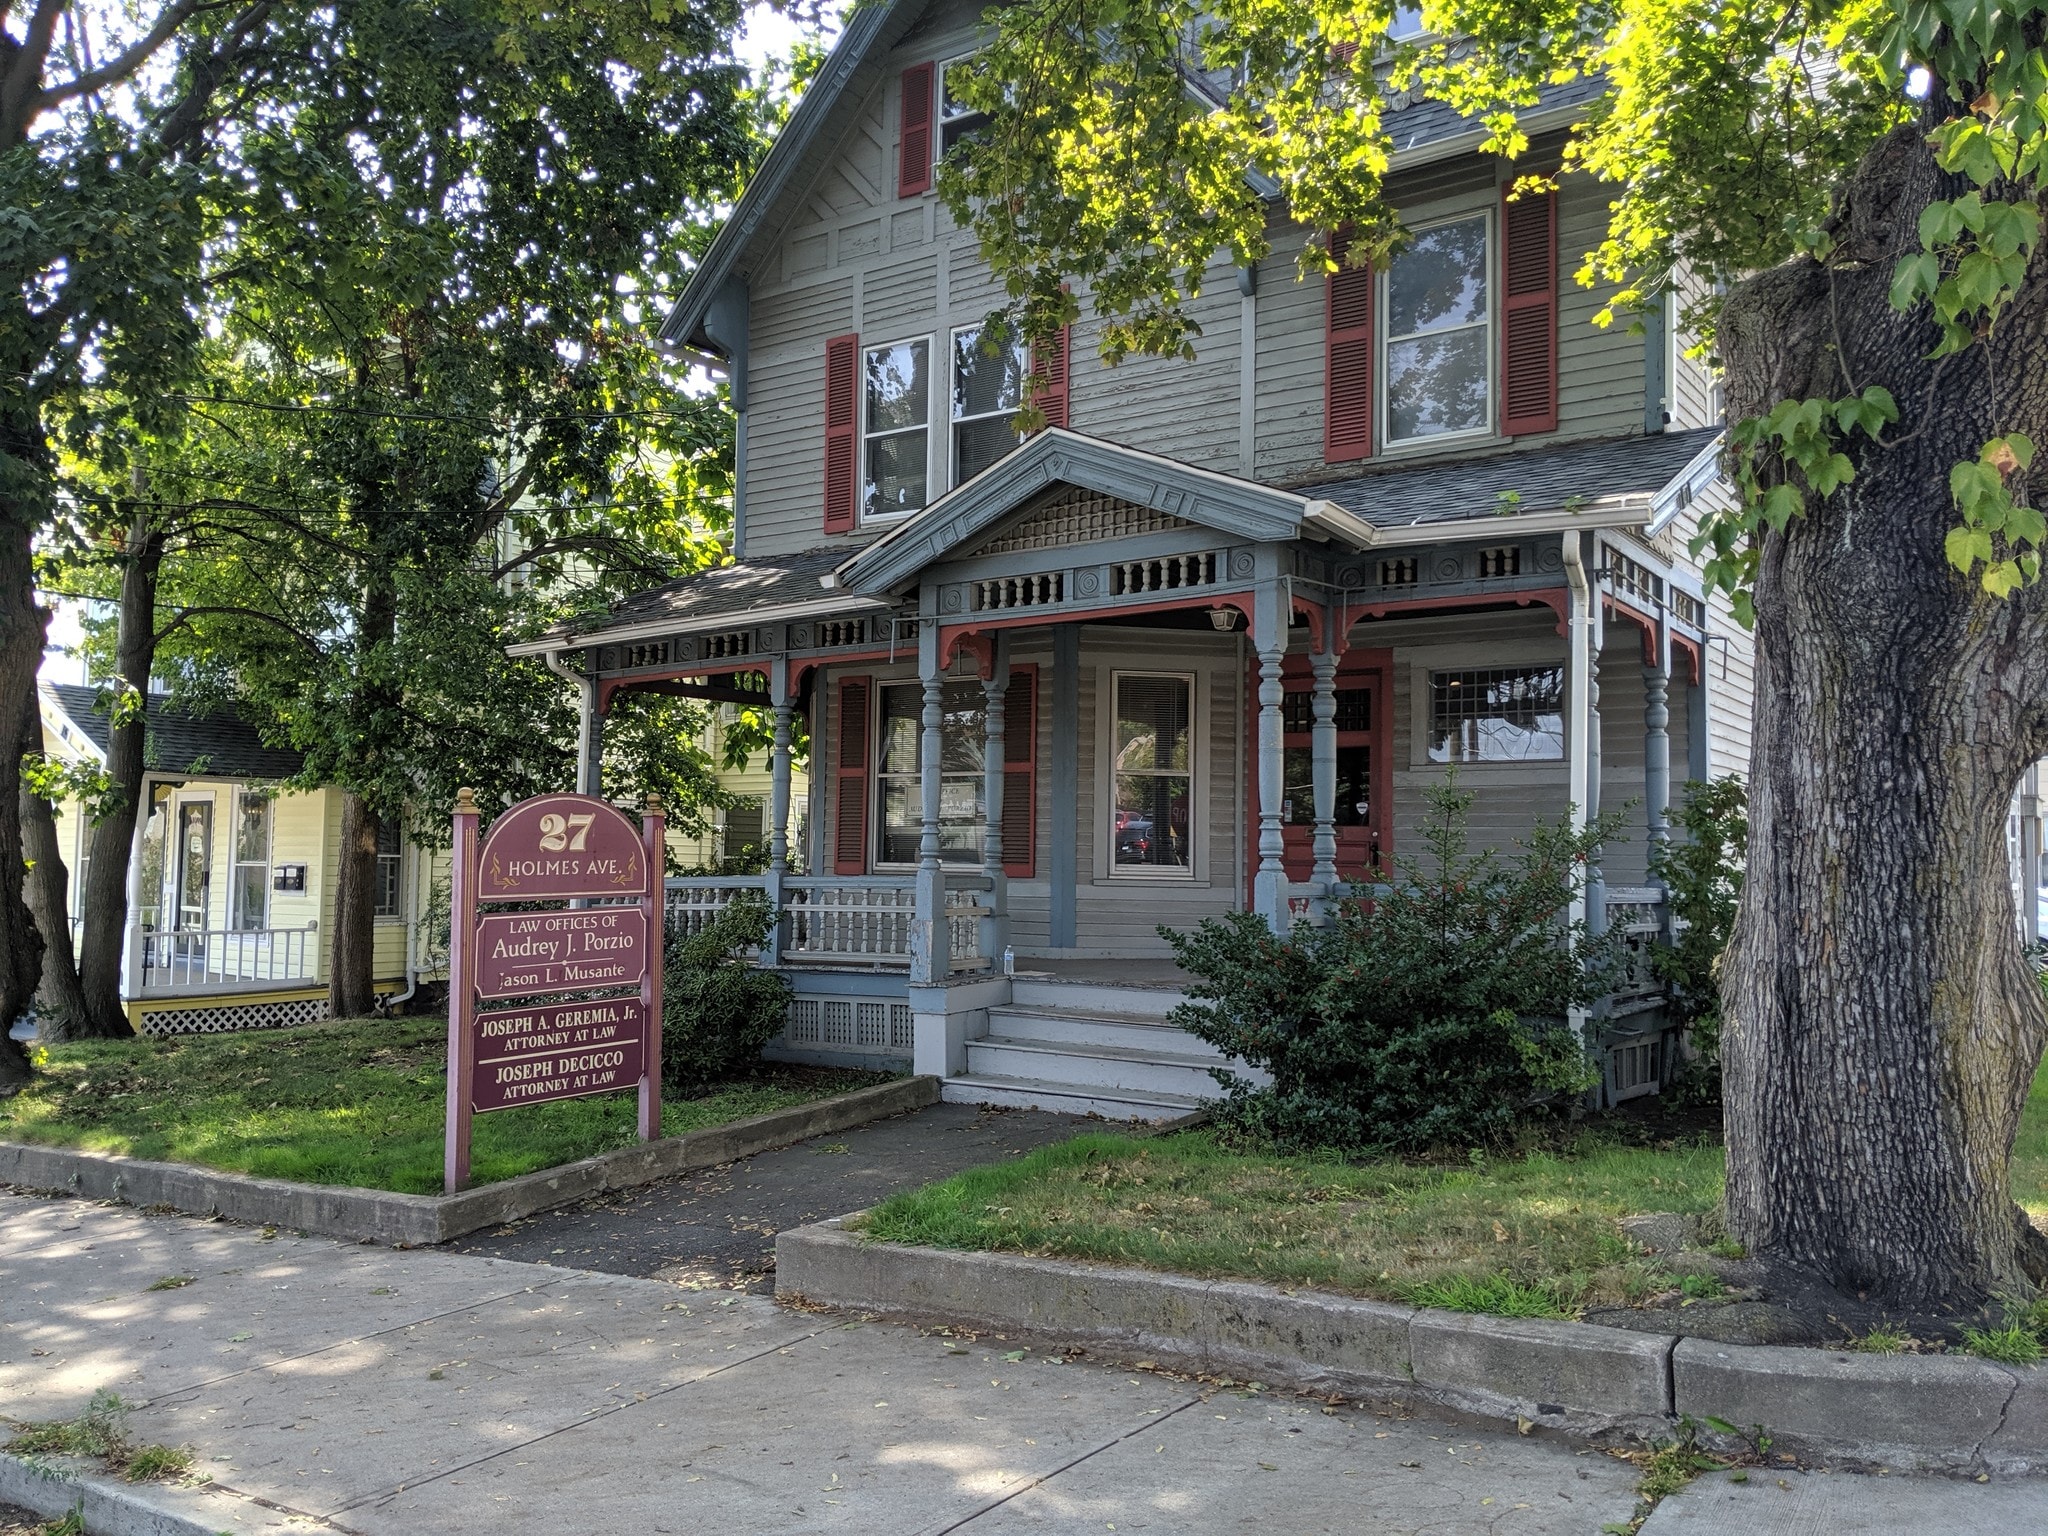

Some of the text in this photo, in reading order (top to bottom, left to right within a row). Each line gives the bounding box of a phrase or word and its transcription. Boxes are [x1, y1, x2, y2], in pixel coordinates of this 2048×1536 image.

[539, 812, 597, 853] 27
[508, 859, 623, 877] HOLMES AVE.
[509, 915, 619, 934] LAW OFFICES OF
[491, 931, 634, 960] Audrey J. Porzio
[545, 968, 558, 983] L.
[564, 963, 626, 981] Musante
[481, 1005, 638, 1038] JOSEPH A. GEREMIA, Jr.
[503, 1025, 617, 1052] ATTORNEY AT LAW
[495, 1050, 624, 1084] JOSEPH DECICCO
[502, 1070, 616, 1100] ATTORNEY AT LAW
